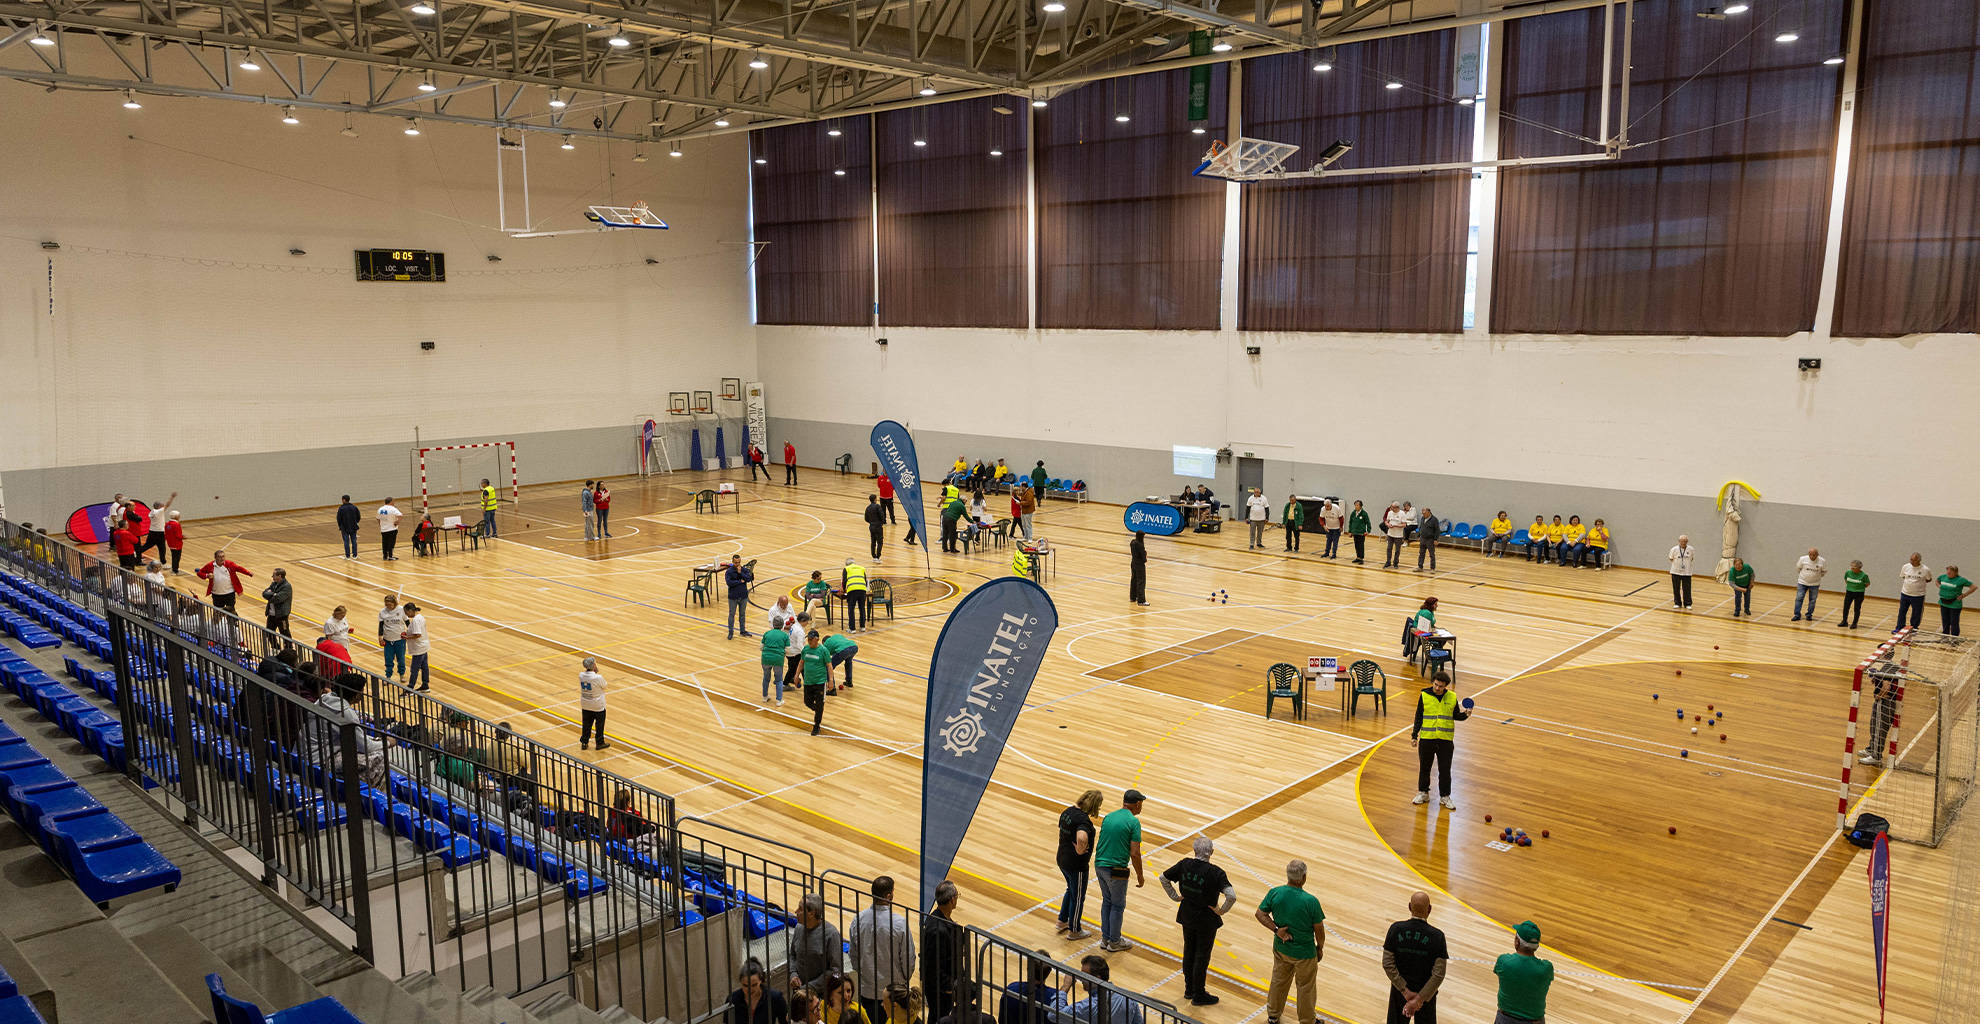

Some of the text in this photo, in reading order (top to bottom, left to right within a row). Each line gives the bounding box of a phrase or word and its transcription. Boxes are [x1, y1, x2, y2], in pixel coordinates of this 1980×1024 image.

[748, 402, 758, 447] VILA REA
[1144, 513, 1173, 526] INATEL
[965, 611, 1029, 709] INATEL
[990, 617, 1038, 713] FUNDAÇÃO
[1397, 930, 1430, 946] ACDR
